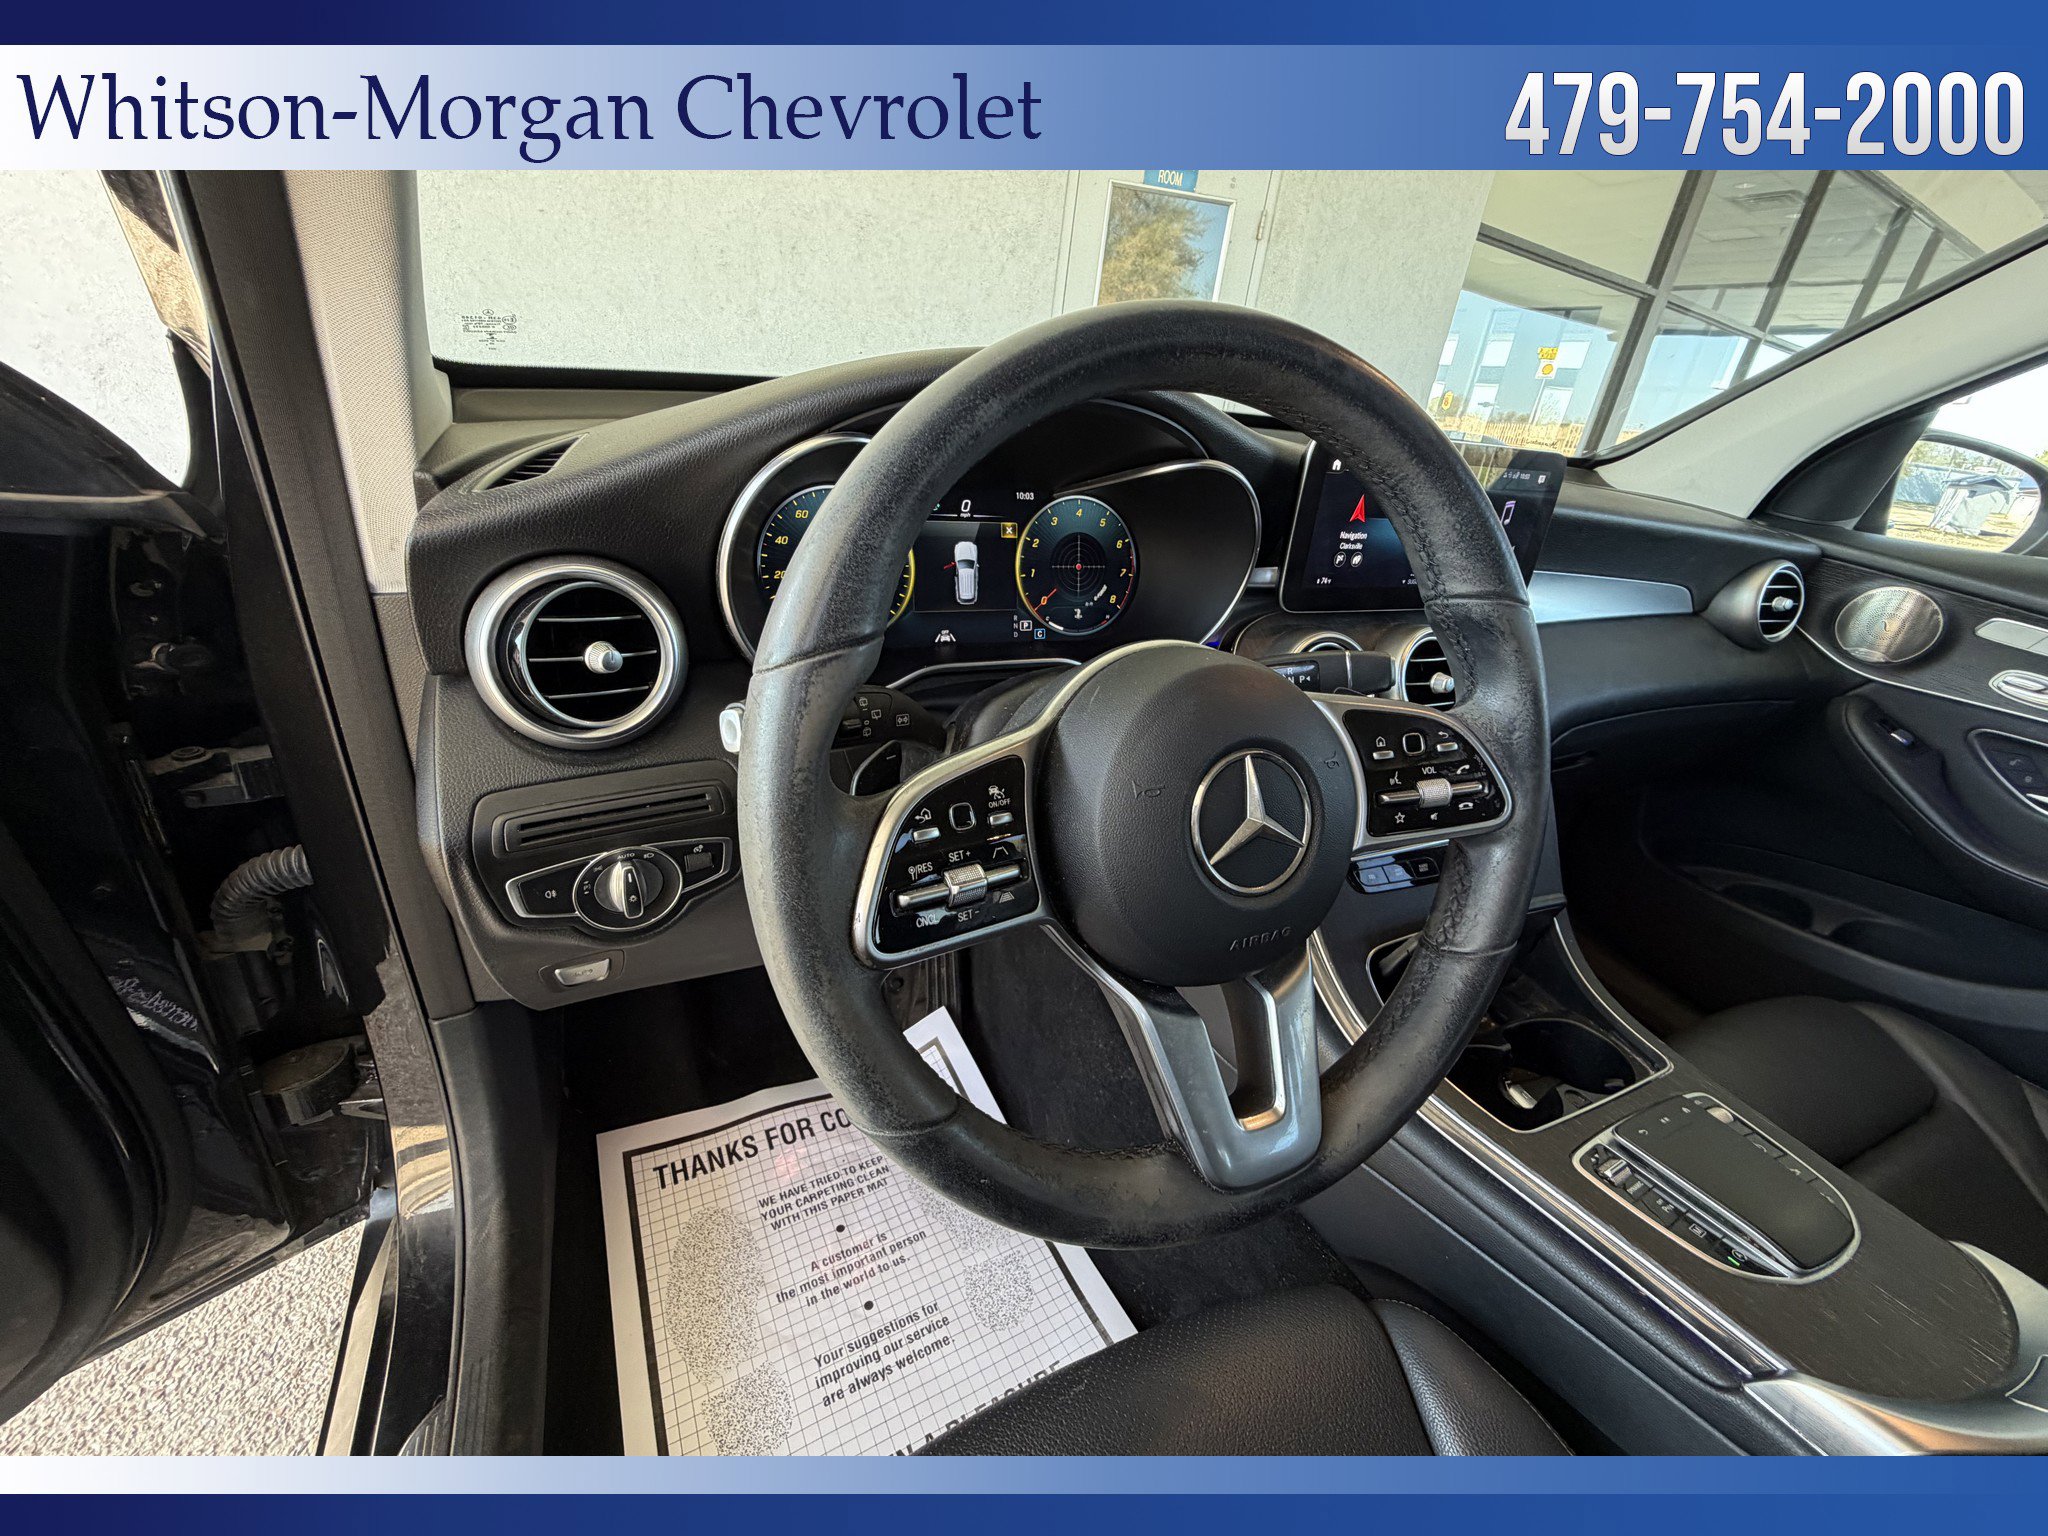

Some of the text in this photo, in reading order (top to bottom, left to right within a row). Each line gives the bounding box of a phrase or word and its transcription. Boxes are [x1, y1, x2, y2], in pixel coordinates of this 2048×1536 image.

[1158, 170, 1183, 186] ROOM
[1016, 492, 1034, 500] 10:03
[961, 500, 971, 512] 0
[795, 510, 808, 519] 60
[1076, 509, 1083, 518] 4
[1051, 517, 1058, 526] 3
[1100, 518, 1106, 527] 5
[775, 536, 788, 545] 40
[1340, 531, 1368, 541] Navigation
[1032, 539, 1040, 548] 2
[1116, 540, 1123, 549] 6
[1031, 569, 1036, 578] 1
[1119, 569, 1127, 577] 7
[1109, 594, 1117, 604] 8
[988, 798, 1011, 809] ON/OFF
[916, 915, 938, 928] CNCL
[1229, 927, 1292, 951] AIRBAG
[652, 1135, 758, 1190] THANKS
[765, 1118, 815, 1150] FOR
[759, 1155, 883, 1208] WE HAVE TRIED TO KEEP
[761, 1165, 890, 1221] YOUR CARPETING CLEAN
[771, 1177, 889, 1231] WITH THIS PAPER MAT
[811, 1232, 888, 1272] A customer is
[776, 1230, 927, 1304] the most important person
[805, 1254, 911, 1307] in the world to us.
[814, 1302, 940, 1368] Your suggestions for
[814, 1316, 950, 1389] improving our service
[822, 1335, 955, 1407] are always welcome.
